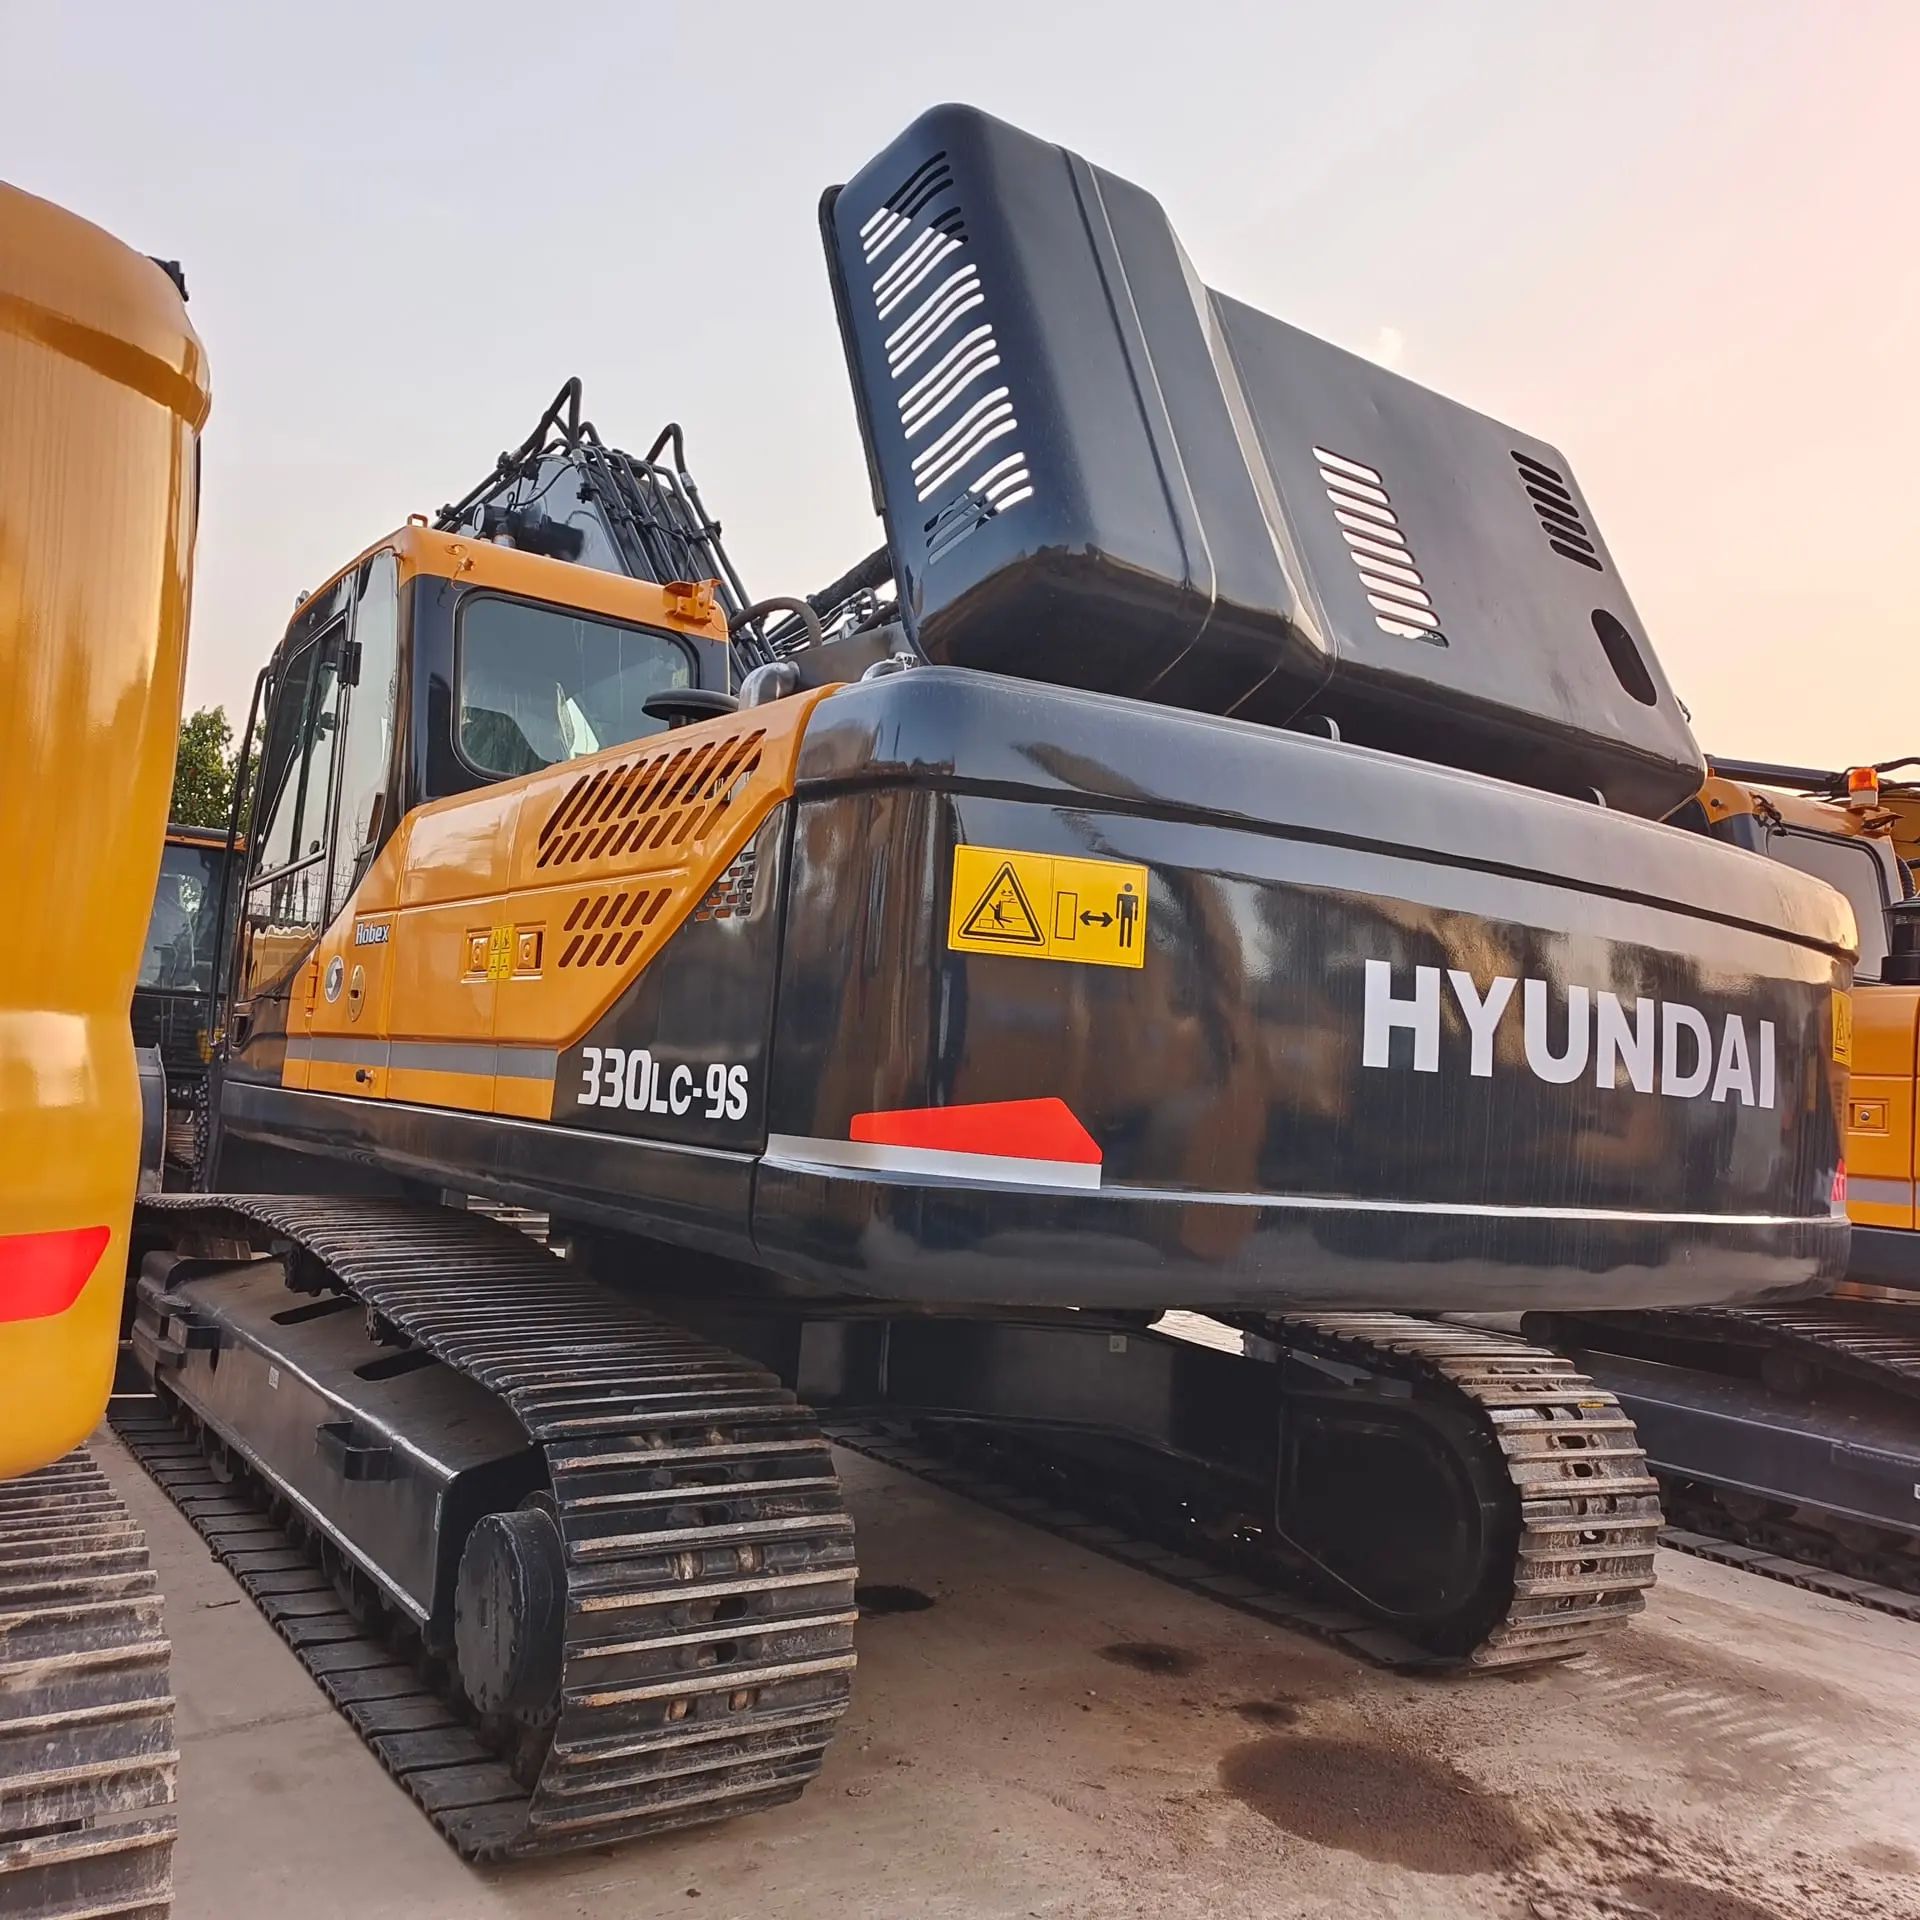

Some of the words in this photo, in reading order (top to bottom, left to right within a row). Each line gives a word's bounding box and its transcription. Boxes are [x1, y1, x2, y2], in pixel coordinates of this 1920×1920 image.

[355, 922, 390, 945] Robex
[1362, 959, 1775, 1109] HYUNDAI
[577, 1047, 749, 1121] 330LC-9S
